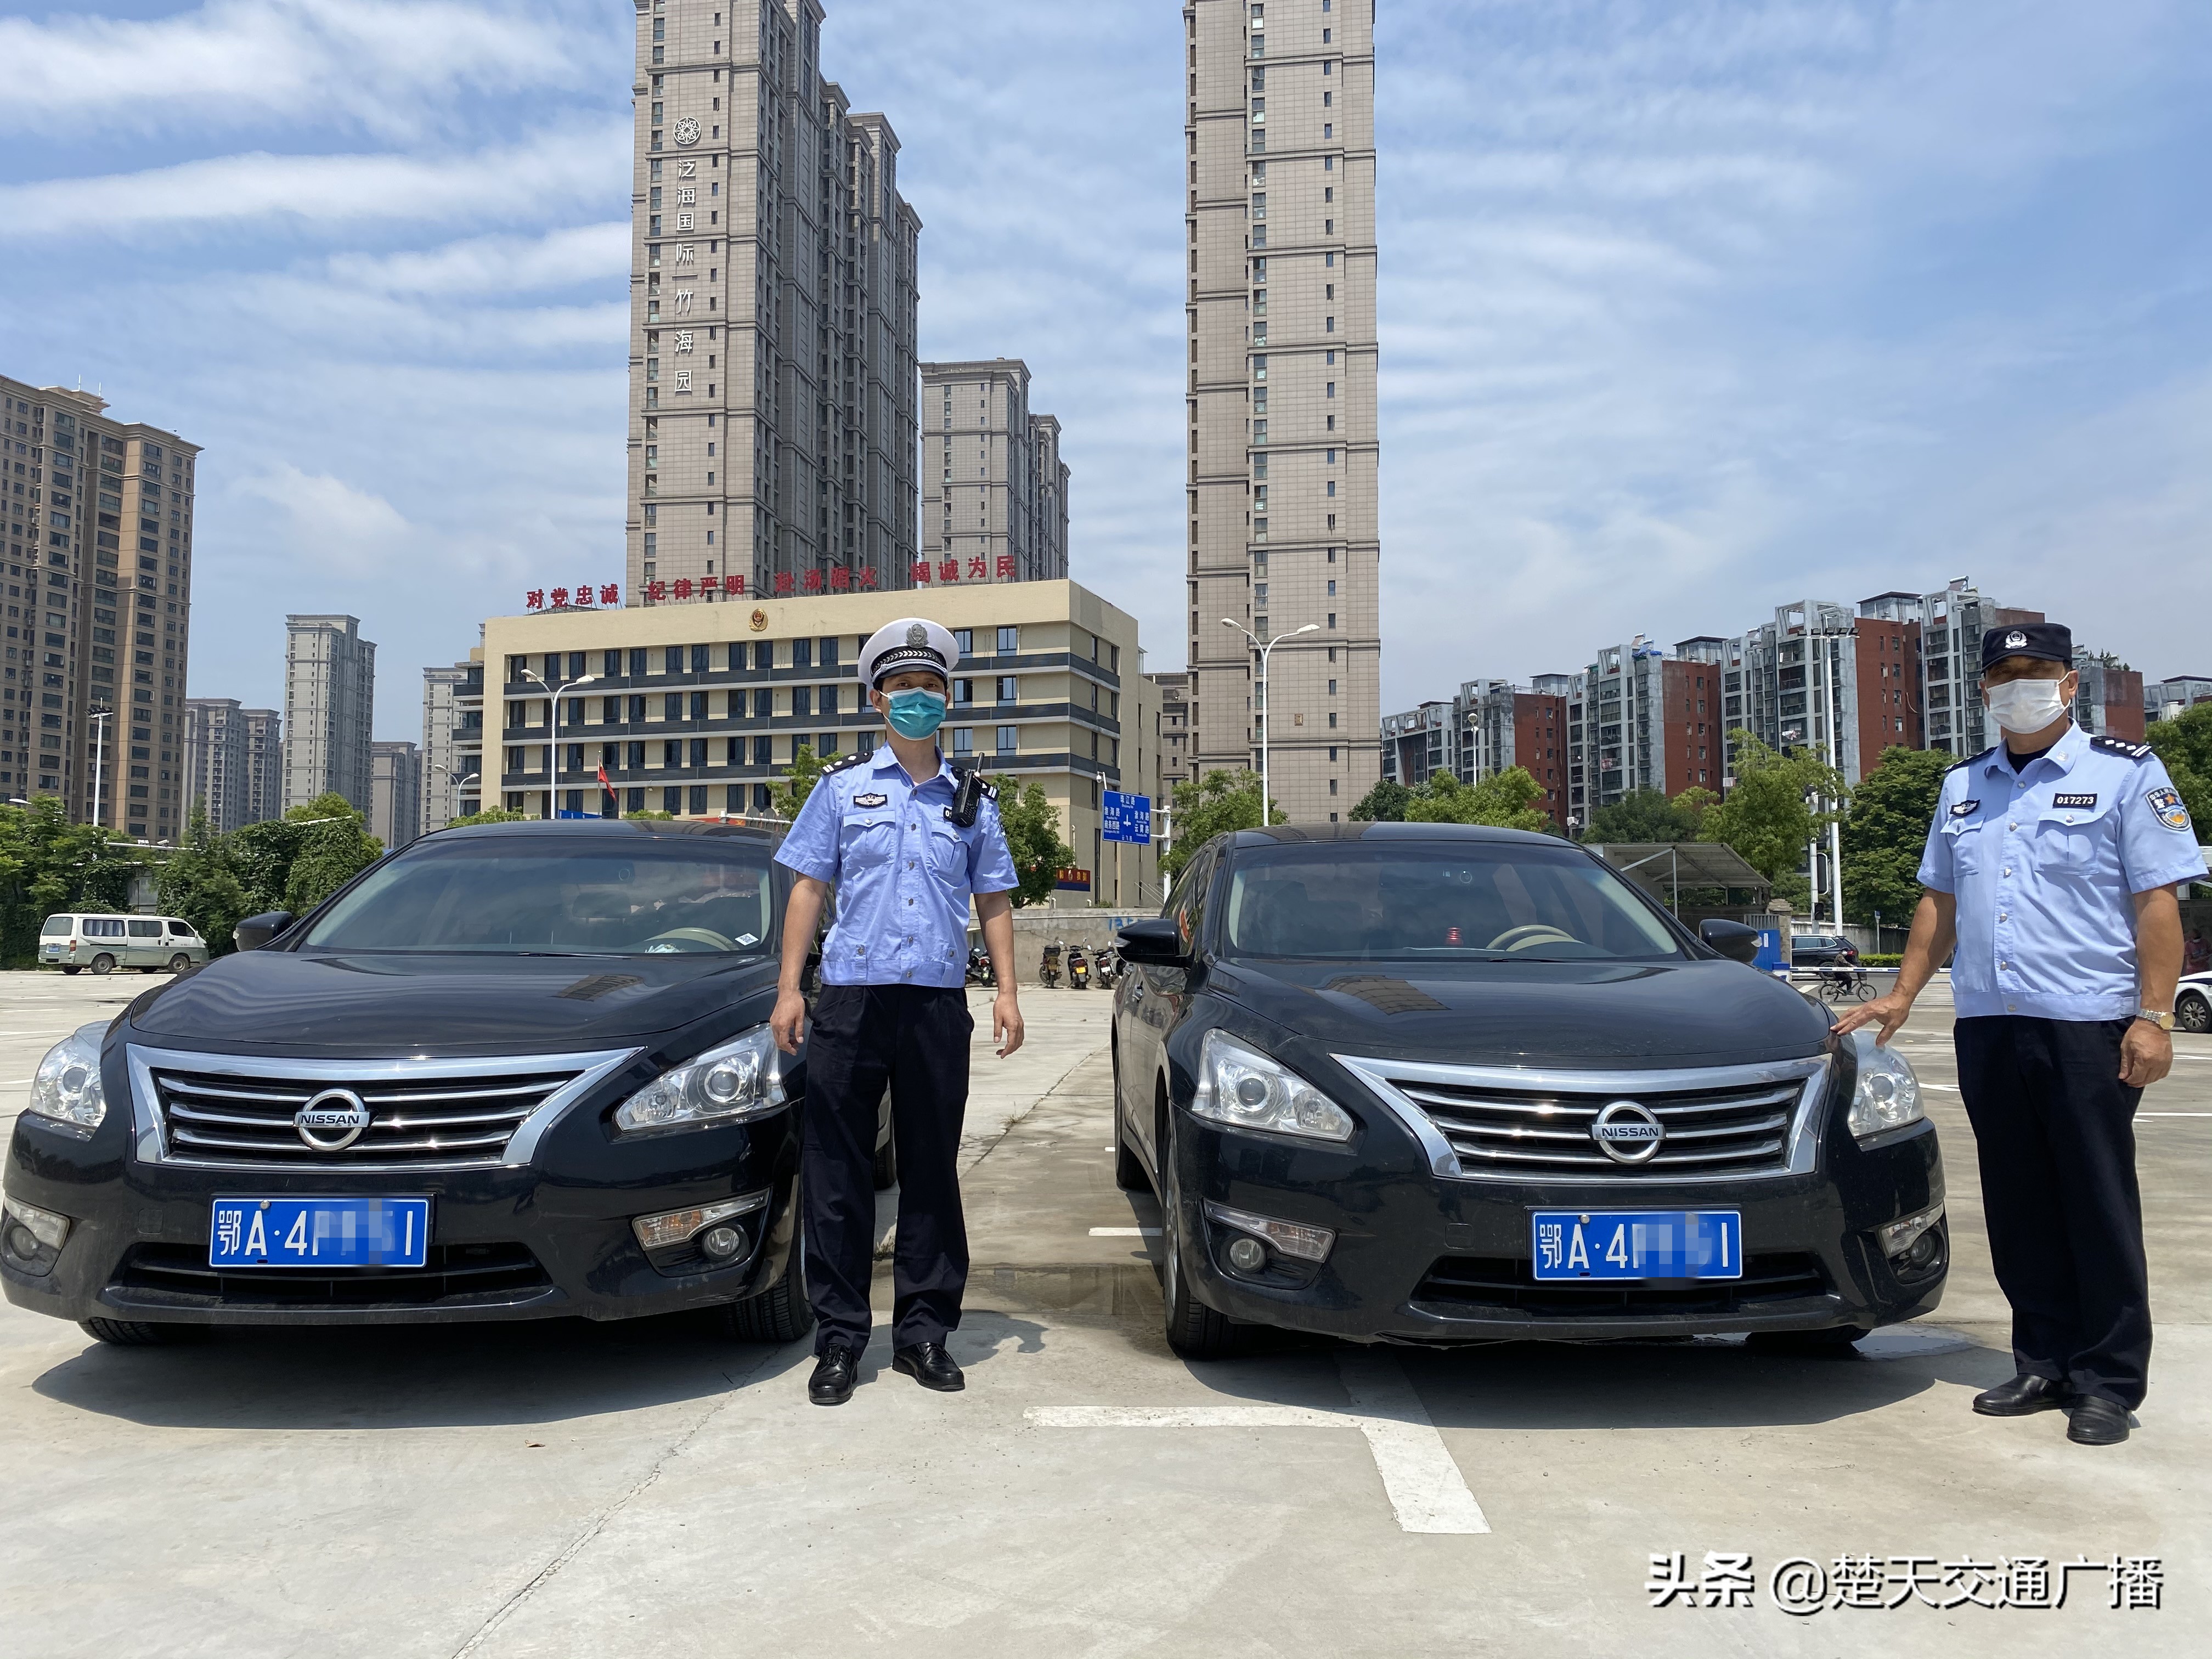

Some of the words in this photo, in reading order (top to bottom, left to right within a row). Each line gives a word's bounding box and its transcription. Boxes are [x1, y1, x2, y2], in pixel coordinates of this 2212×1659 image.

[526, 583, 619, 610] 对党忠诚
[647, 574, 745, 601] 纪律严明
[774, 564, 877, 592] 赴汤蹈火
[909, 555, 1016, 583] 竭诚为民
[2057, 796, 2094, 804] 017273
[300, 1115, 360, 1125] NISSAN
[1601, 1127, 1659, 1137] NISSAN
